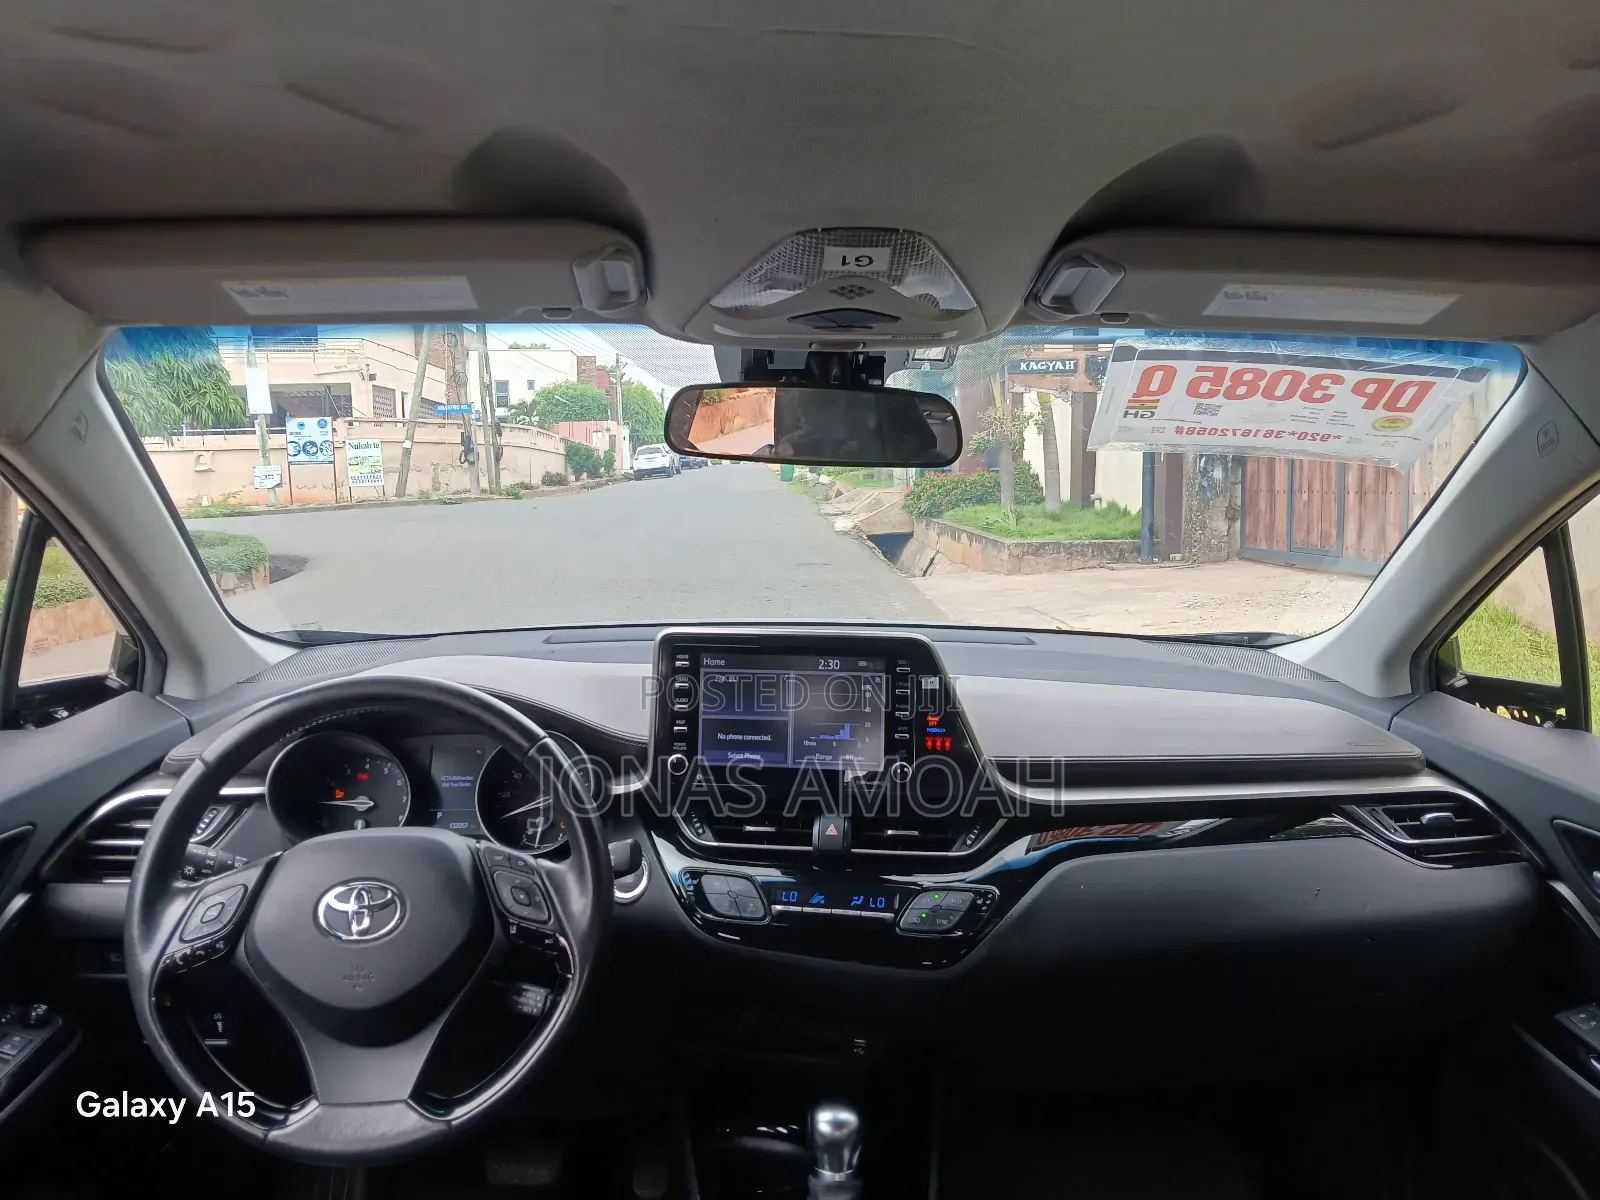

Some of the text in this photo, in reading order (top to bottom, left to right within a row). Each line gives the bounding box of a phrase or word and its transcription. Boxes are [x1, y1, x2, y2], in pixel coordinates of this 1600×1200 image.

[841, 254, 874, 267] G1
[1020, 360, 1077, 372] KAGYAH
[703, 657, 726, 666] Home
[818, 659, 841, 670] 2:30
[717, 732, 773, 742] No phone connected.
[815, 752, 833, 761] Range
[383, 767, 389, 775] 5
[437, 811, 443, 820] P
[782, 891, 798, 902] LO
[869, 897, 885, 908] LO
